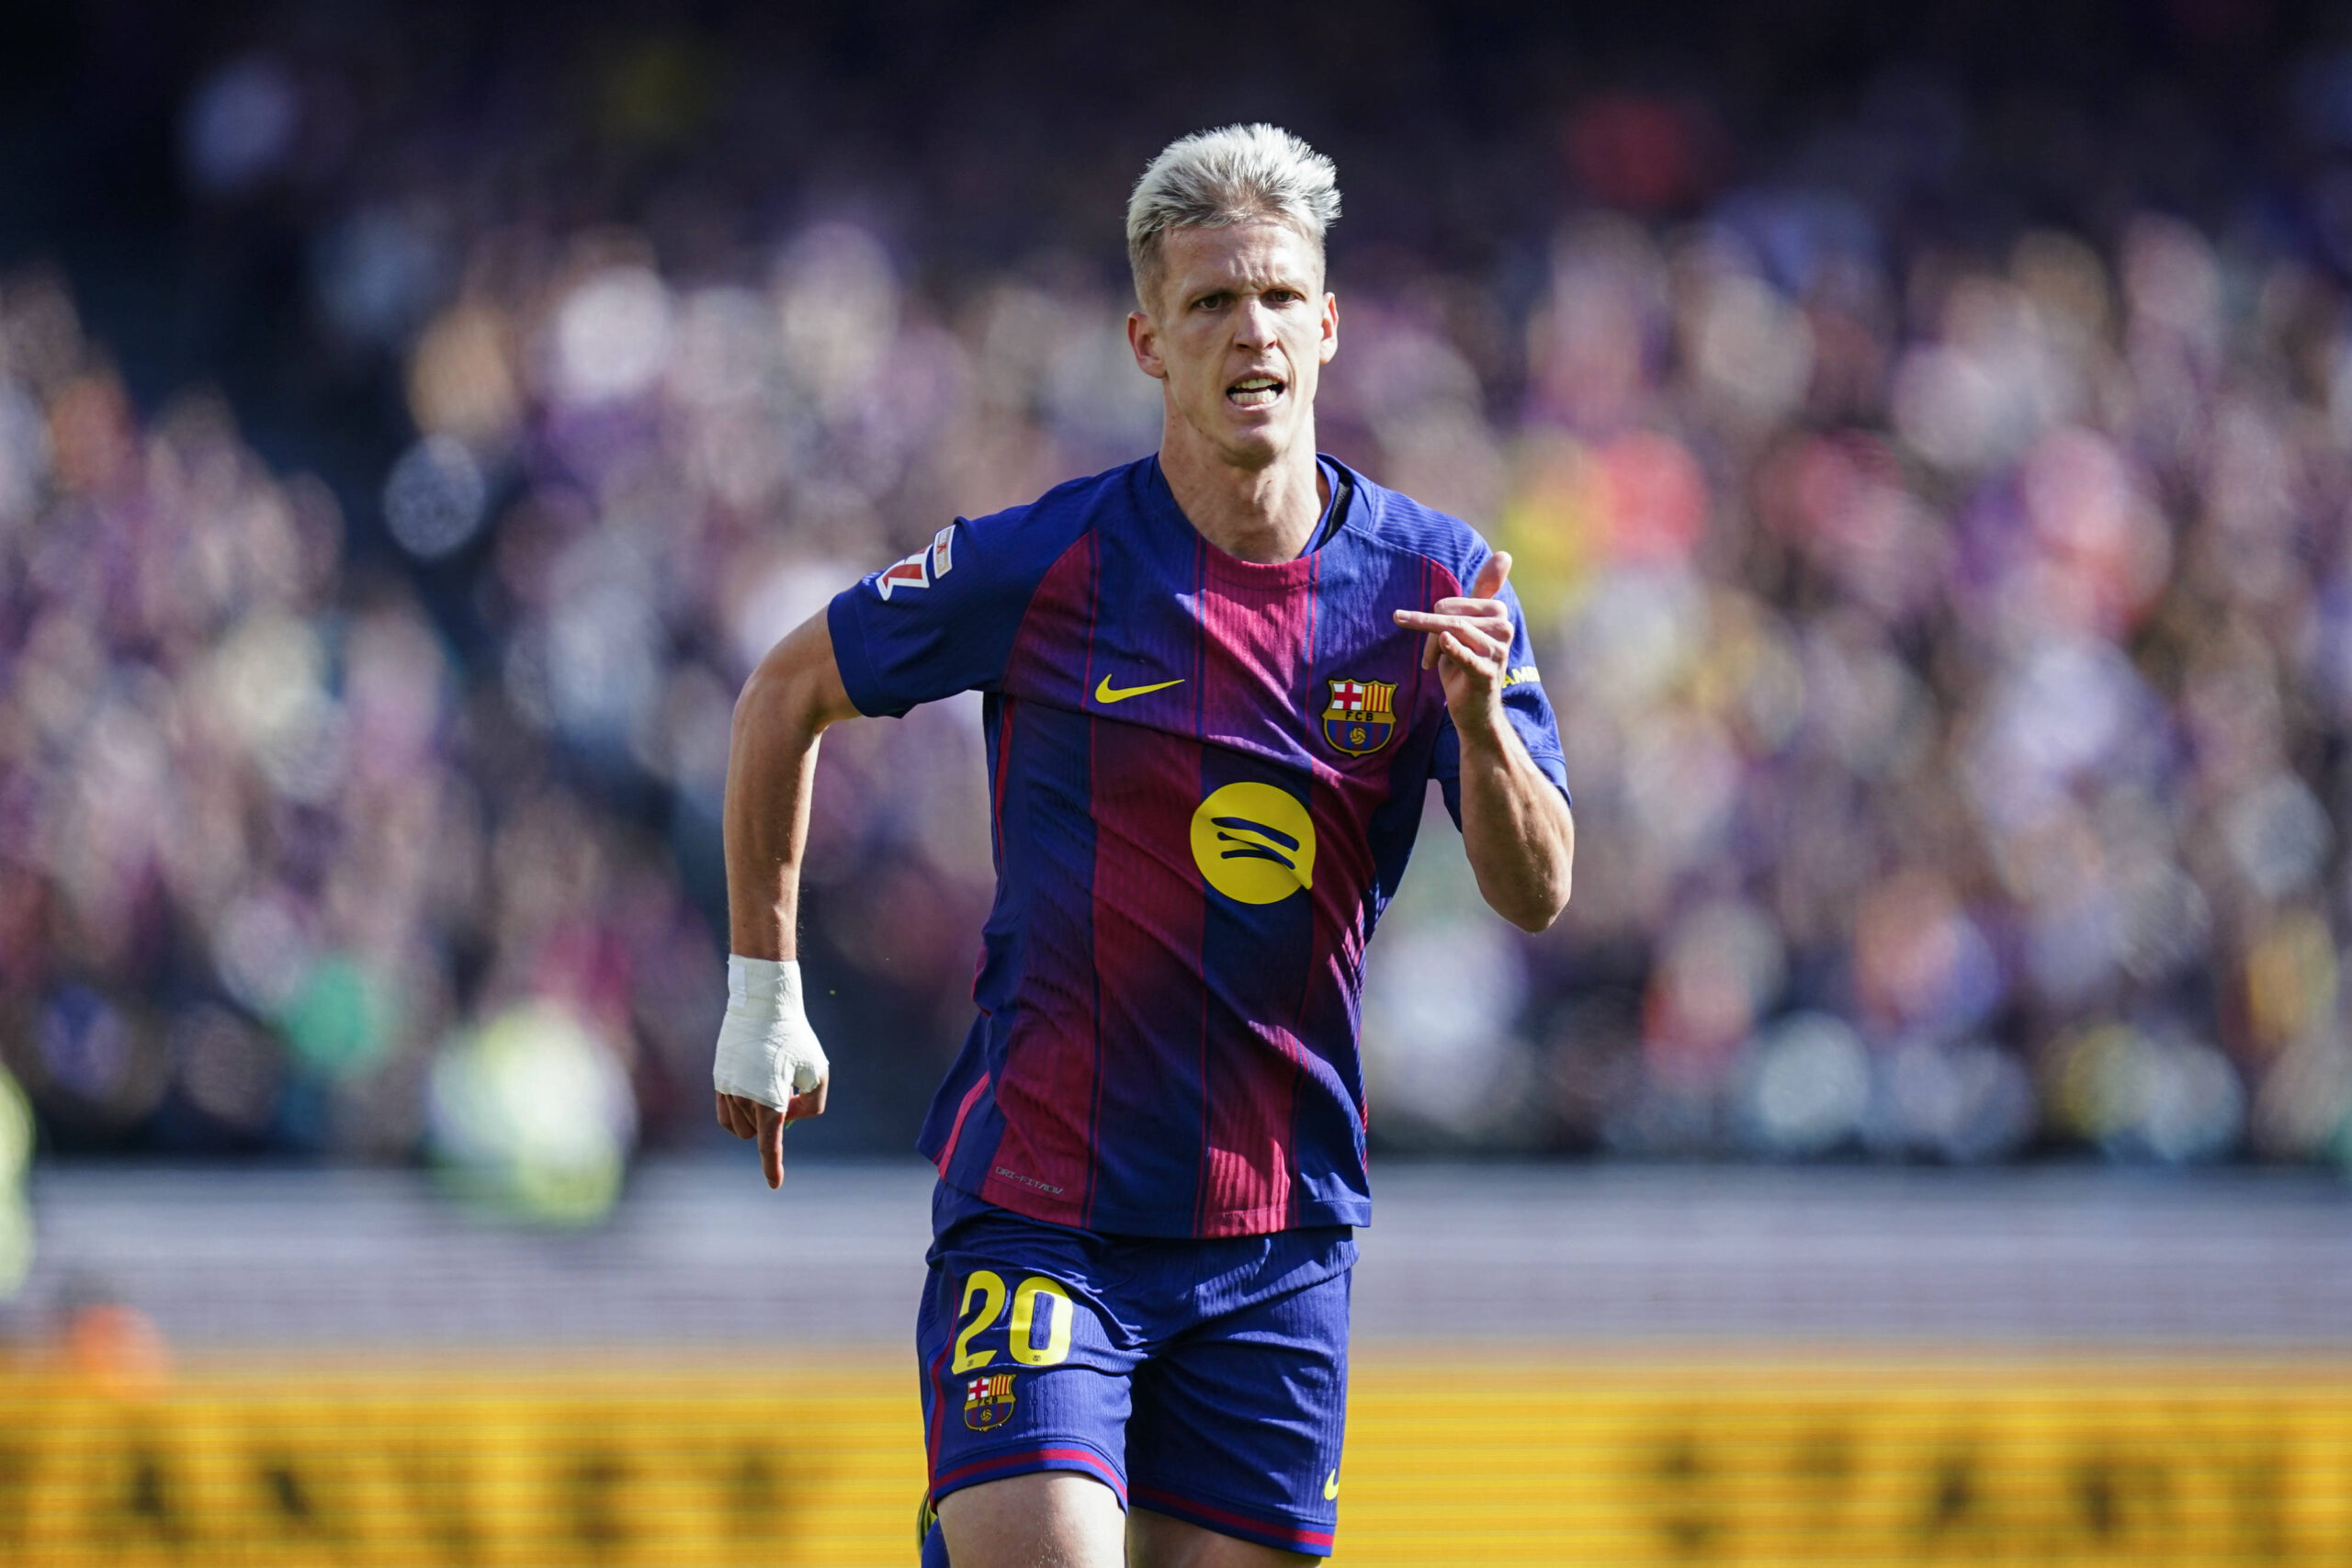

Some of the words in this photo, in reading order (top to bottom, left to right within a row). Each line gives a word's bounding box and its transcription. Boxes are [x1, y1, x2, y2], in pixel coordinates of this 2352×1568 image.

[1345, 711, 1374, 722] FCB
[951, 1269, 1074, 1375] 20
[977, 1396, 999, 1407] FCB
